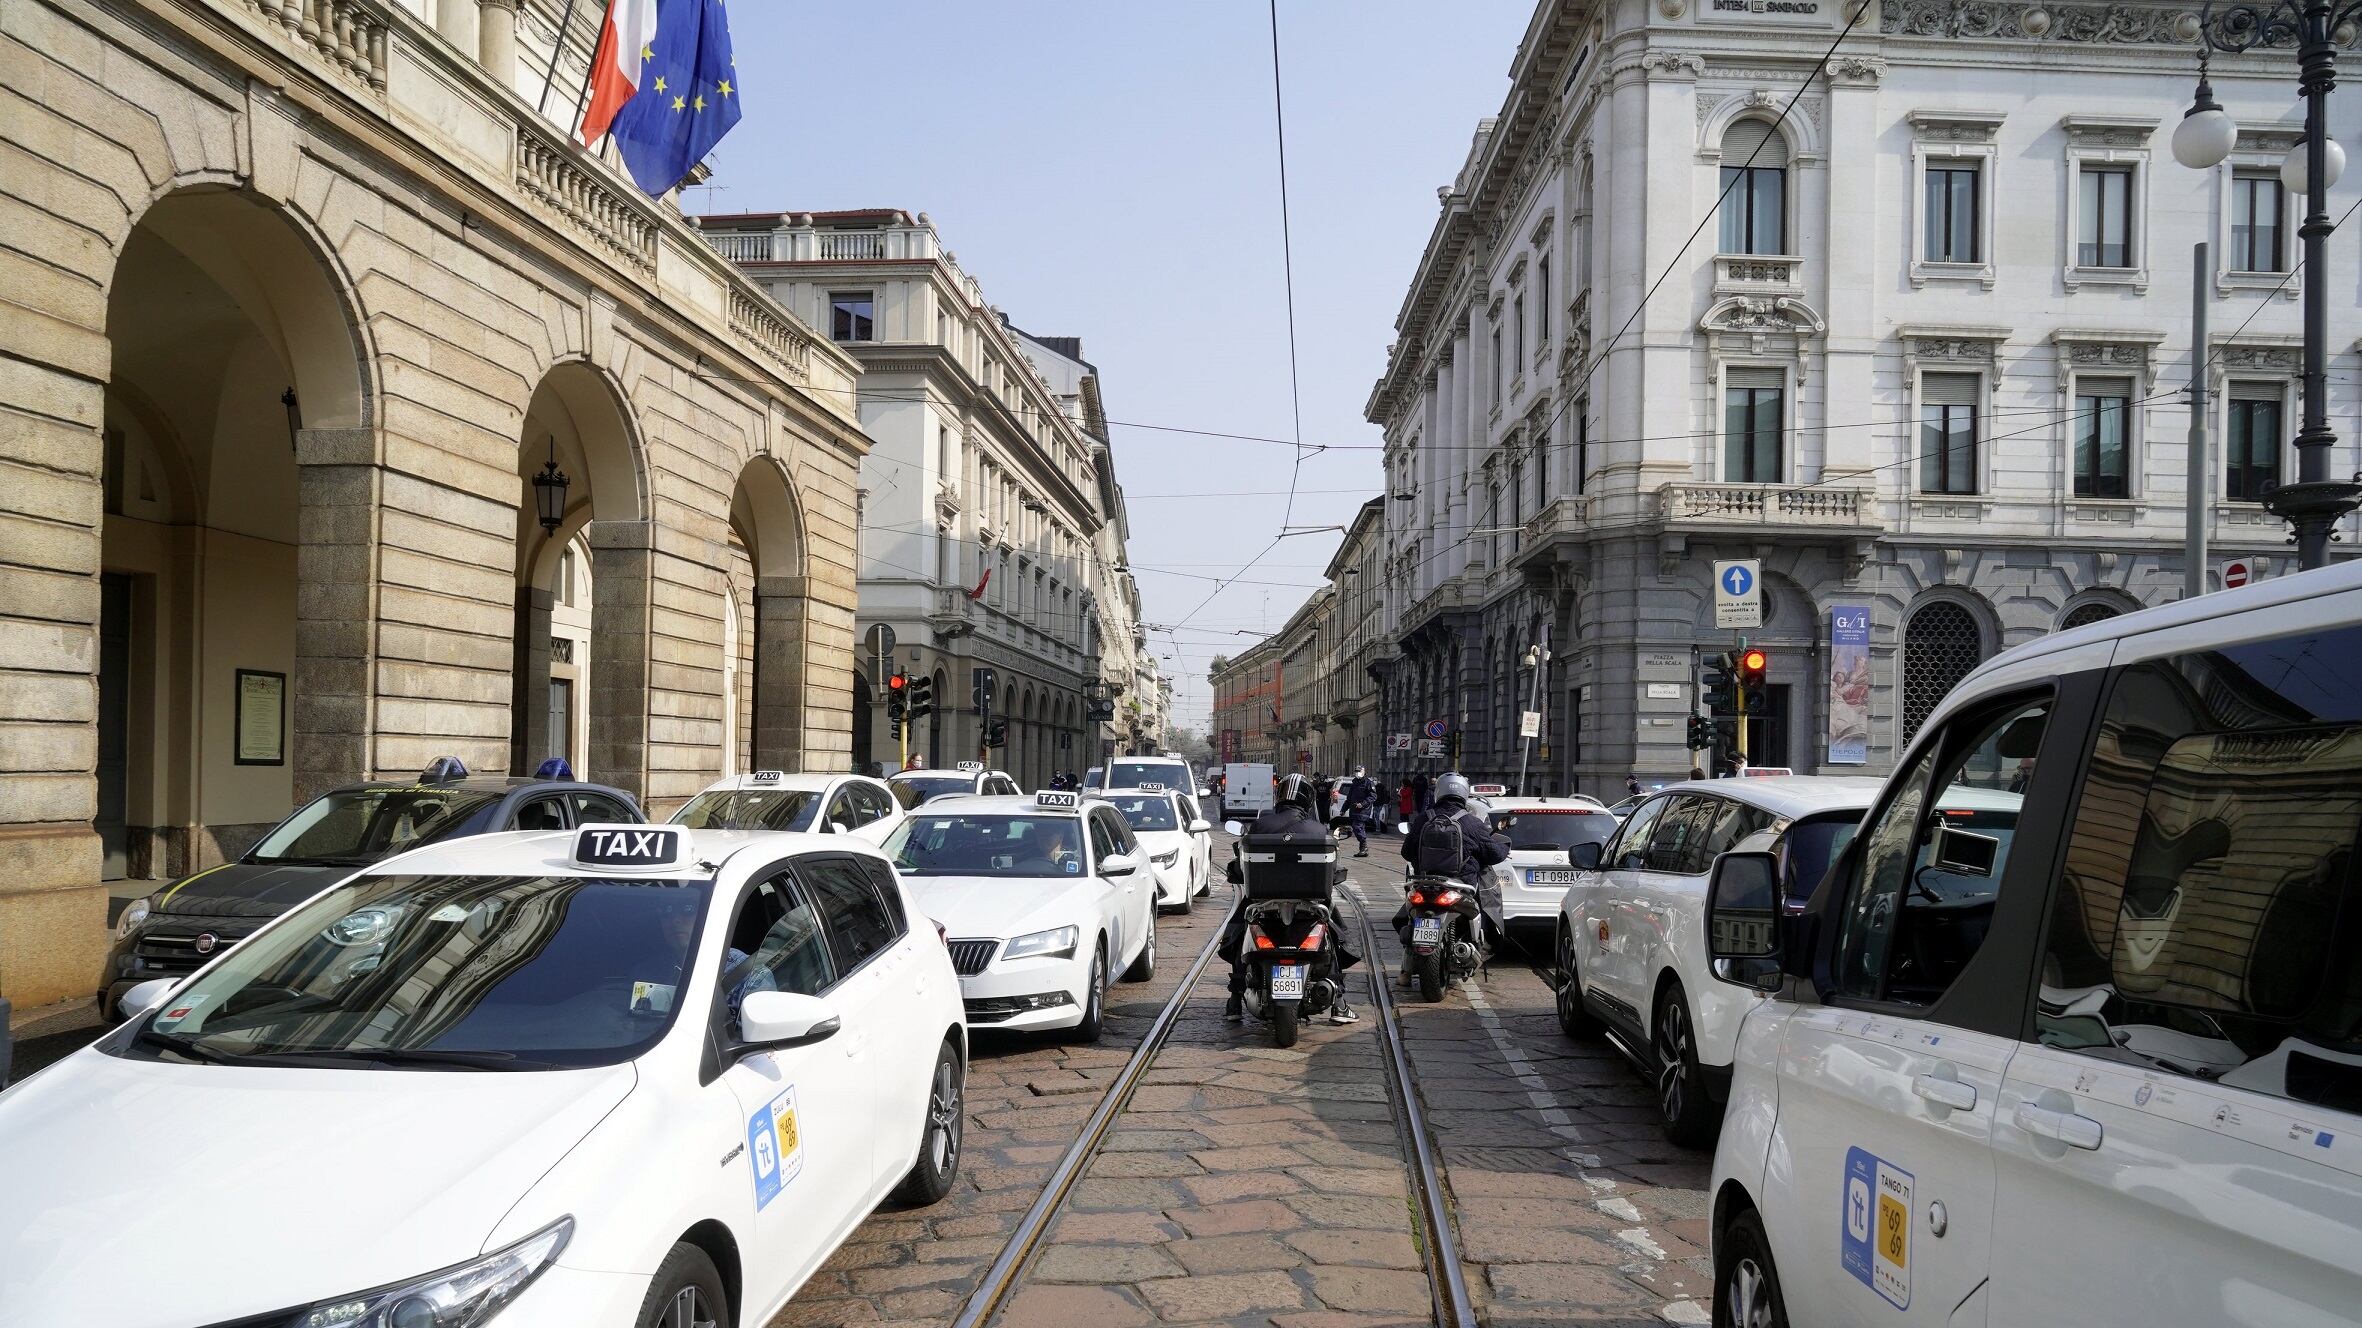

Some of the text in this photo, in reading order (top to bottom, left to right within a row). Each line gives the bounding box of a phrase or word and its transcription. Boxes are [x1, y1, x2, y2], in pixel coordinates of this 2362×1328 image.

[1713, 0, 1818, 14] INTESA SANPAOLO
[1040, 794, 1071, 805] TAXI
[591, 831, 665, 858] TAXI
[1534, 871, 1546, 882] ET
[1280, 966, 1291, 978] CJ
[1273, 980, 1301, 992] 56891
[785, 1117, 793, 1134] 69
[788, 1130, 796, 1148] 69
[1881, 1174, 1910, 1199] TANGO 71
[1888, 1208, 1901, 1233] 69
[1890, 1233, 1902, 1258] 69
